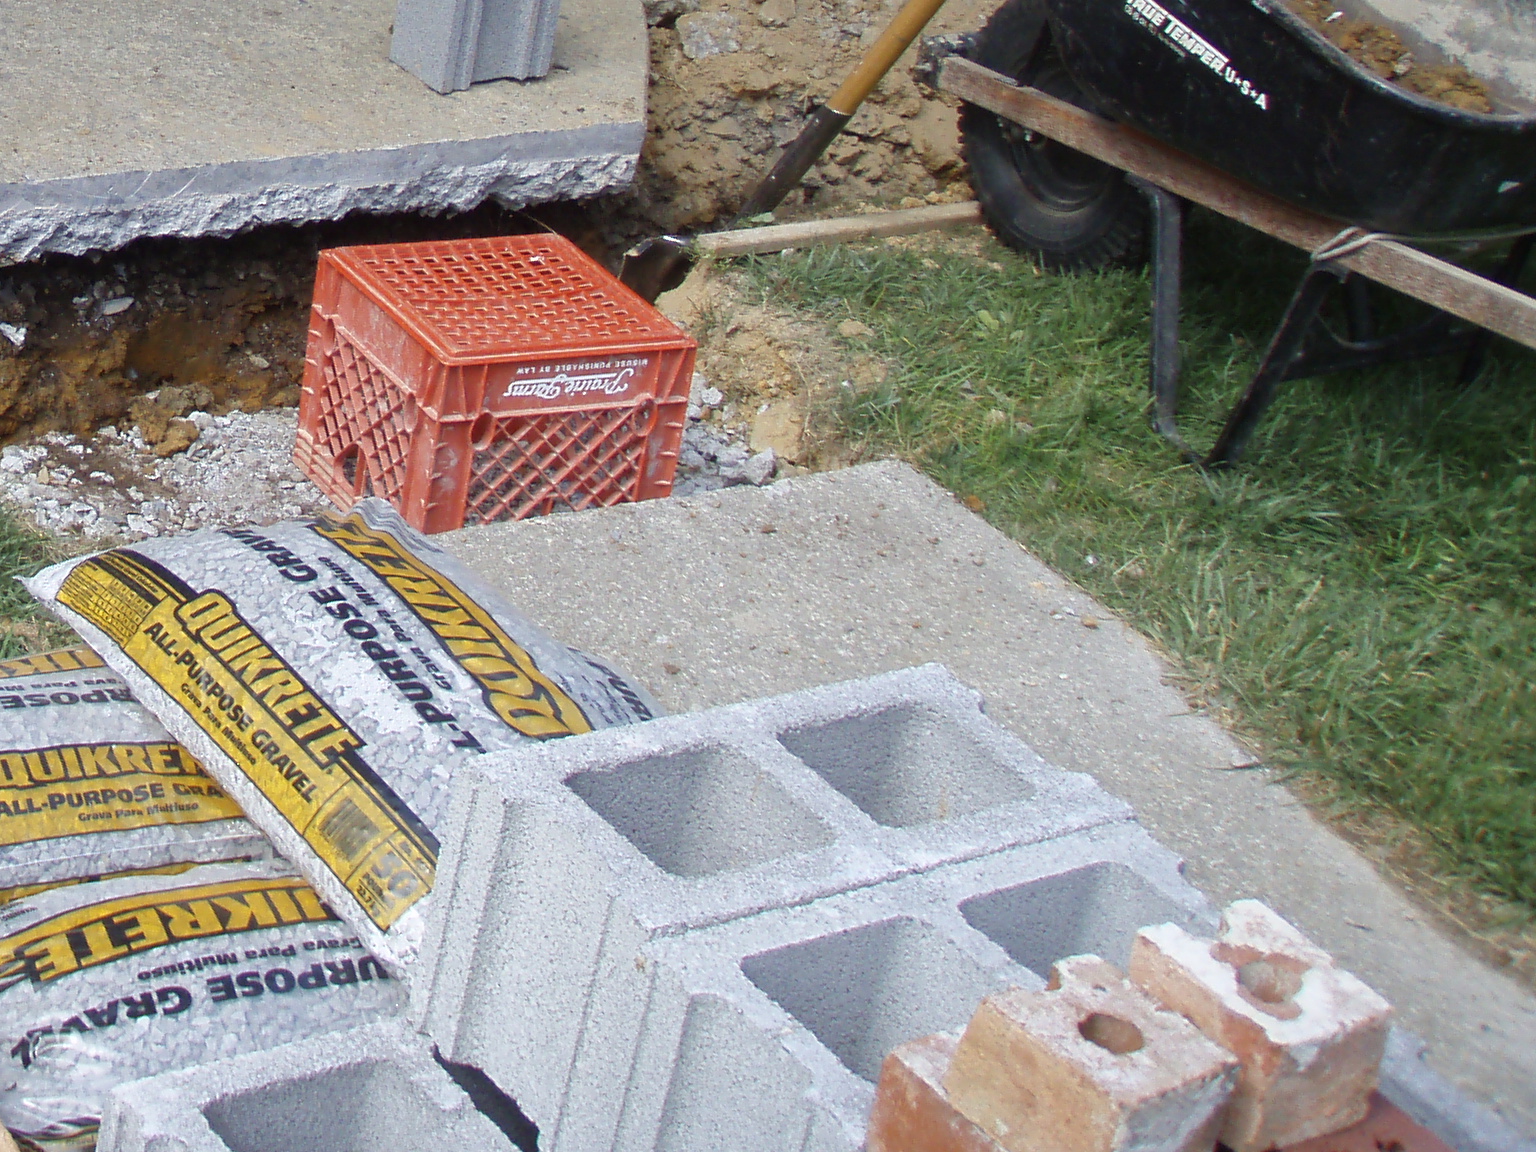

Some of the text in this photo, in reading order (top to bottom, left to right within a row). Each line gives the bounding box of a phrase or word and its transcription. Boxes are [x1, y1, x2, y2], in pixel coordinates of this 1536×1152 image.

[1164, 13, 1230, 76] TEMPER
[516, 358, 649, 375] MISUSE PUNISHABLE BY LAW
[502, 368, 634, 400] Prairie Farms
[319, 555, 379, 608] Multiuso
[376, 609, 415, 643] Para
[29, 679, 77, 692] Para
[177, 590, 363, 769] QUIKRETE
[143, 619, 319, 803] ALL-PURPOSE GRAVEL
[180, 681, 258, 766] Grava Para Multiuso
[77, 800, 200, 824] Grava Para Multiuso
[371, 850, 419, 899] 50
[137, 953, 239, 981] Multiuso
[243, 943, 296, 961] Para
